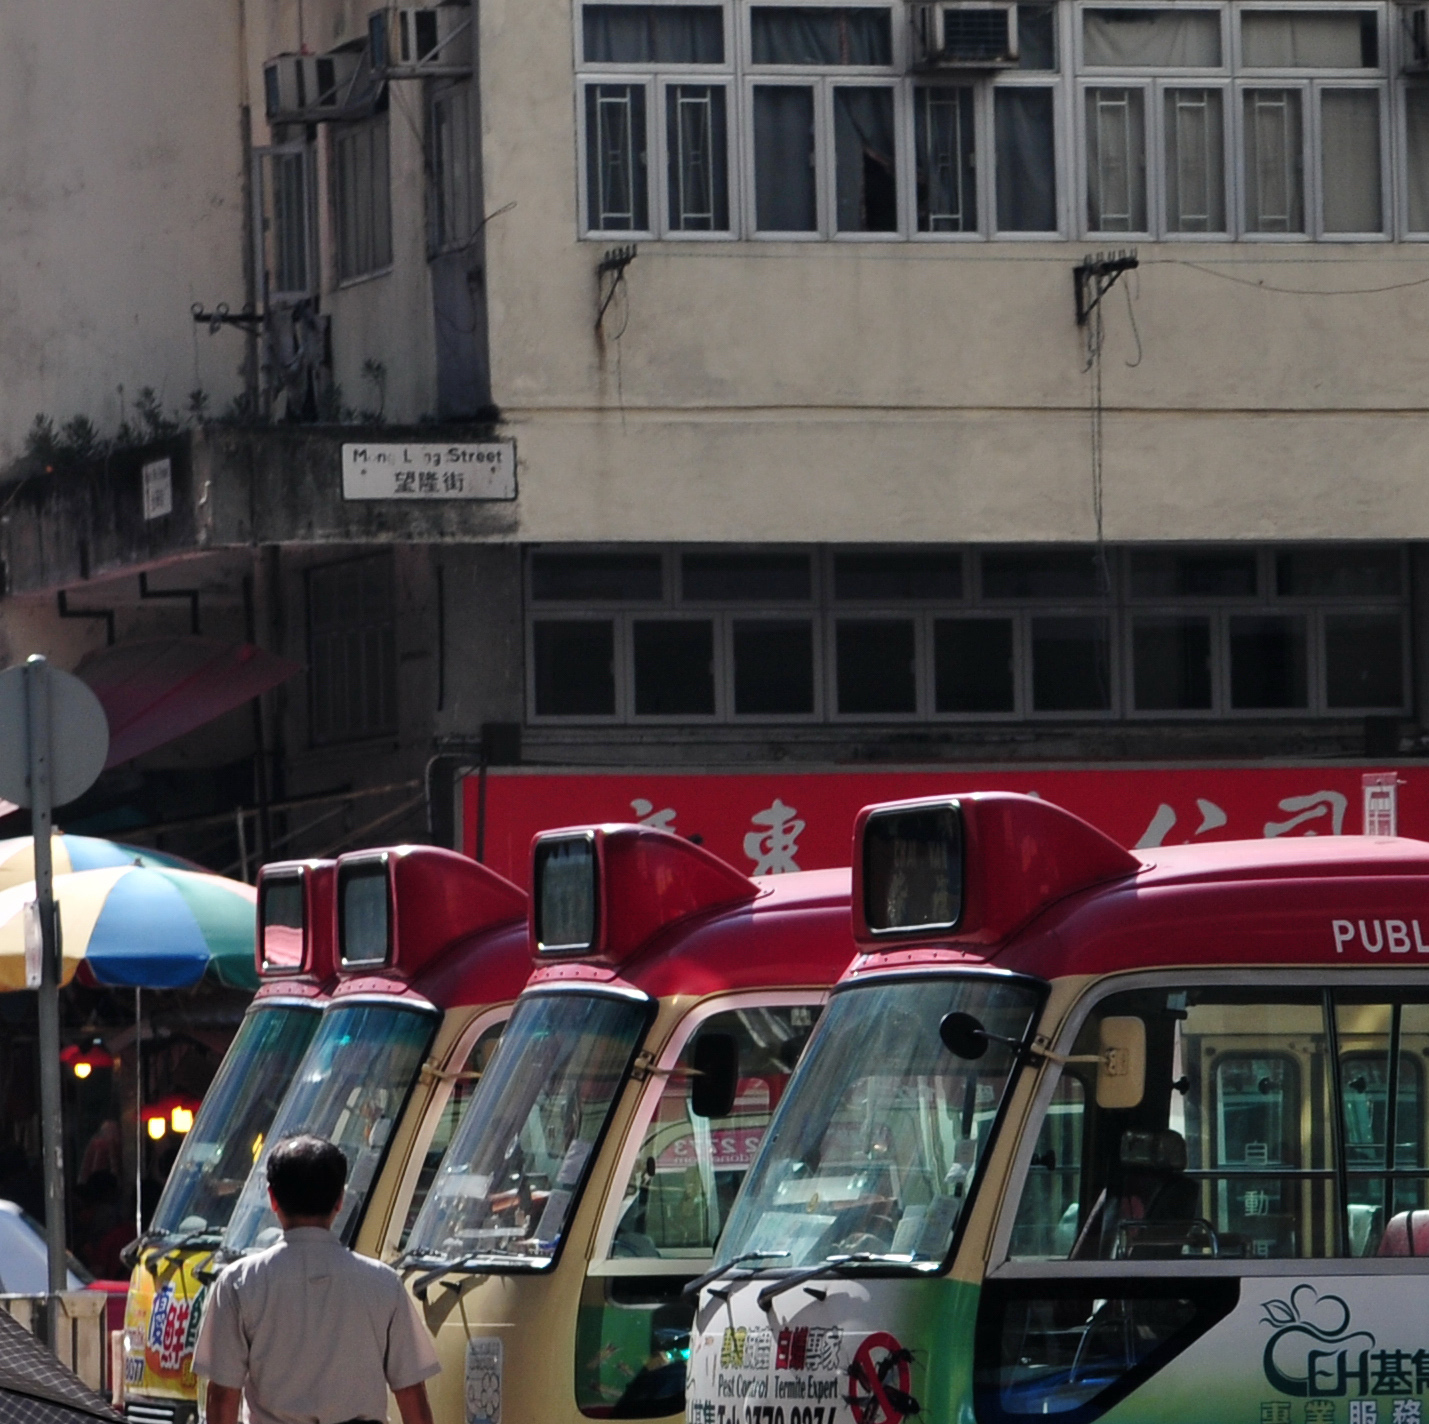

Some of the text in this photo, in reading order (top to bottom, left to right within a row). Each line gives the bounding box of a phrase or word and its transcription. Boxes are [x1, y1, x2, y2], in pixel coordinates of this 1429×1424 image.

[448, 448, 502, 464] Street
[394, 471, 464, 493] 望隆街
[718, 1373, 838, 1403] Pest Control Termite Expert
